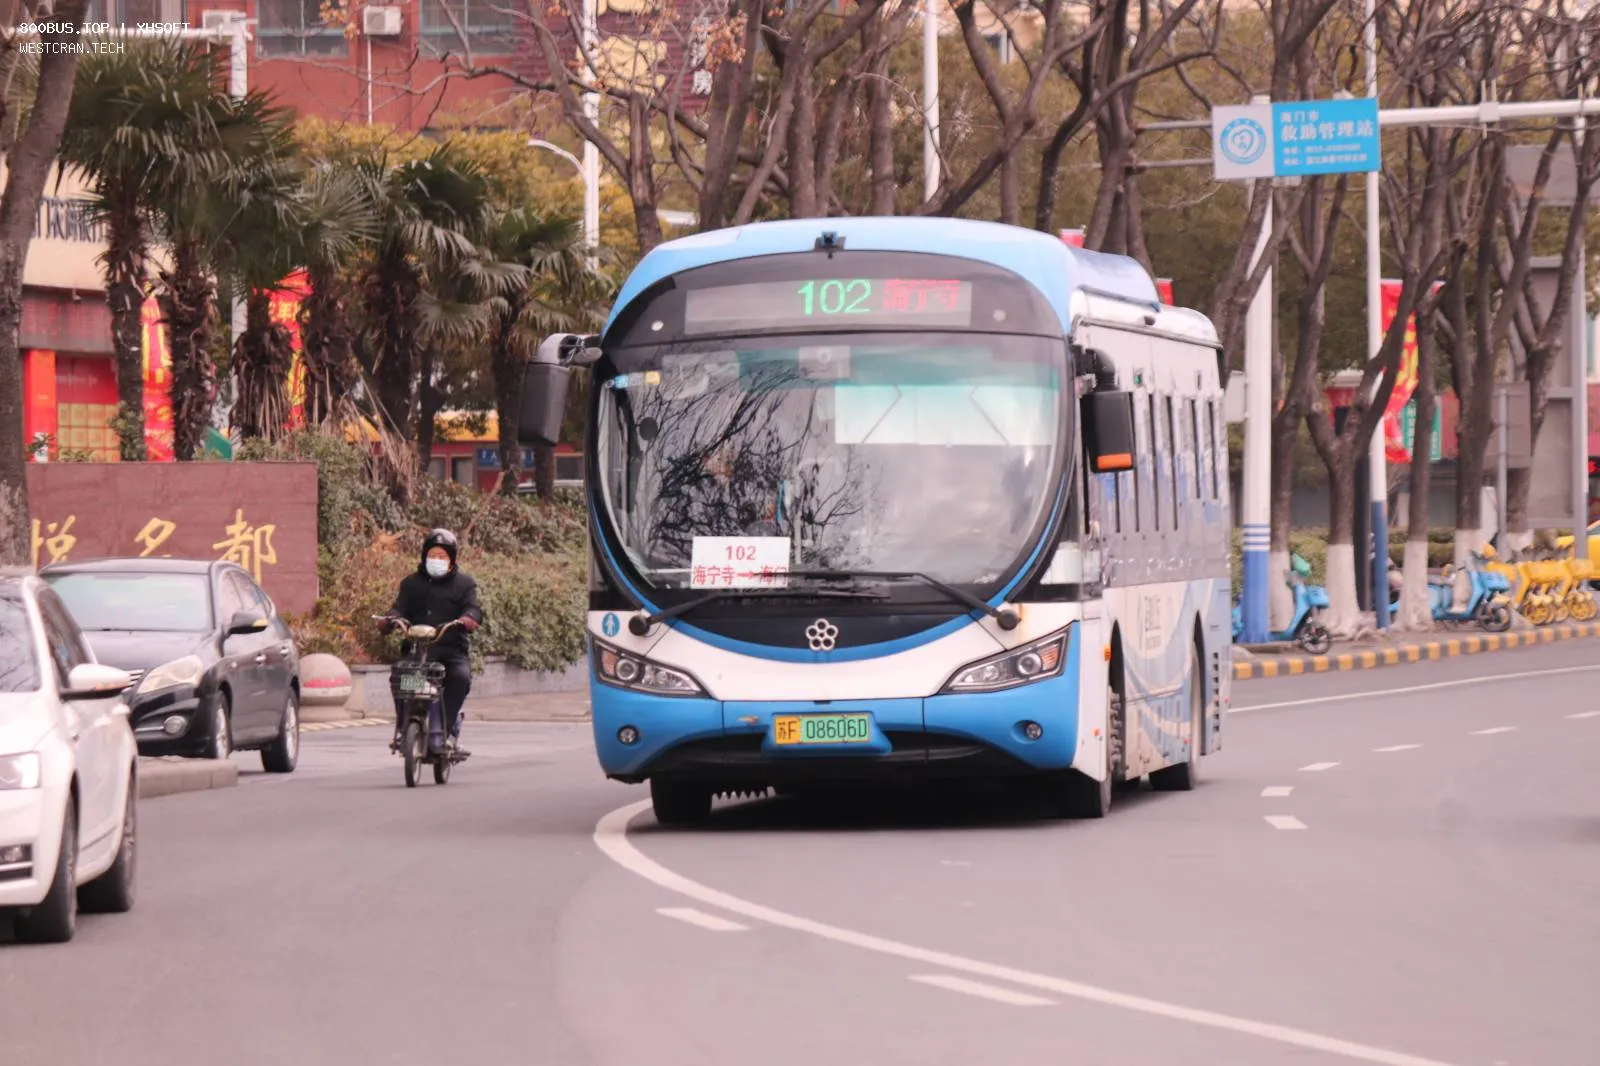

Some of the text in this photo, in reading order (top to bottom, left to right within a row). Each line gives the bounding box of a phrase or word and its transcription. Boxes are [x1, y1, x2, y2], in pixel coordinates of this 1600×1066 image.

[1282, 120, 1373, 141] 救助管理站
[797, 279, 872, 316] 102
[725, 545, 757, 561] 102
[692, 565, 735, 585] 海宁寺
[806, 718, 868, 739] 08606D
